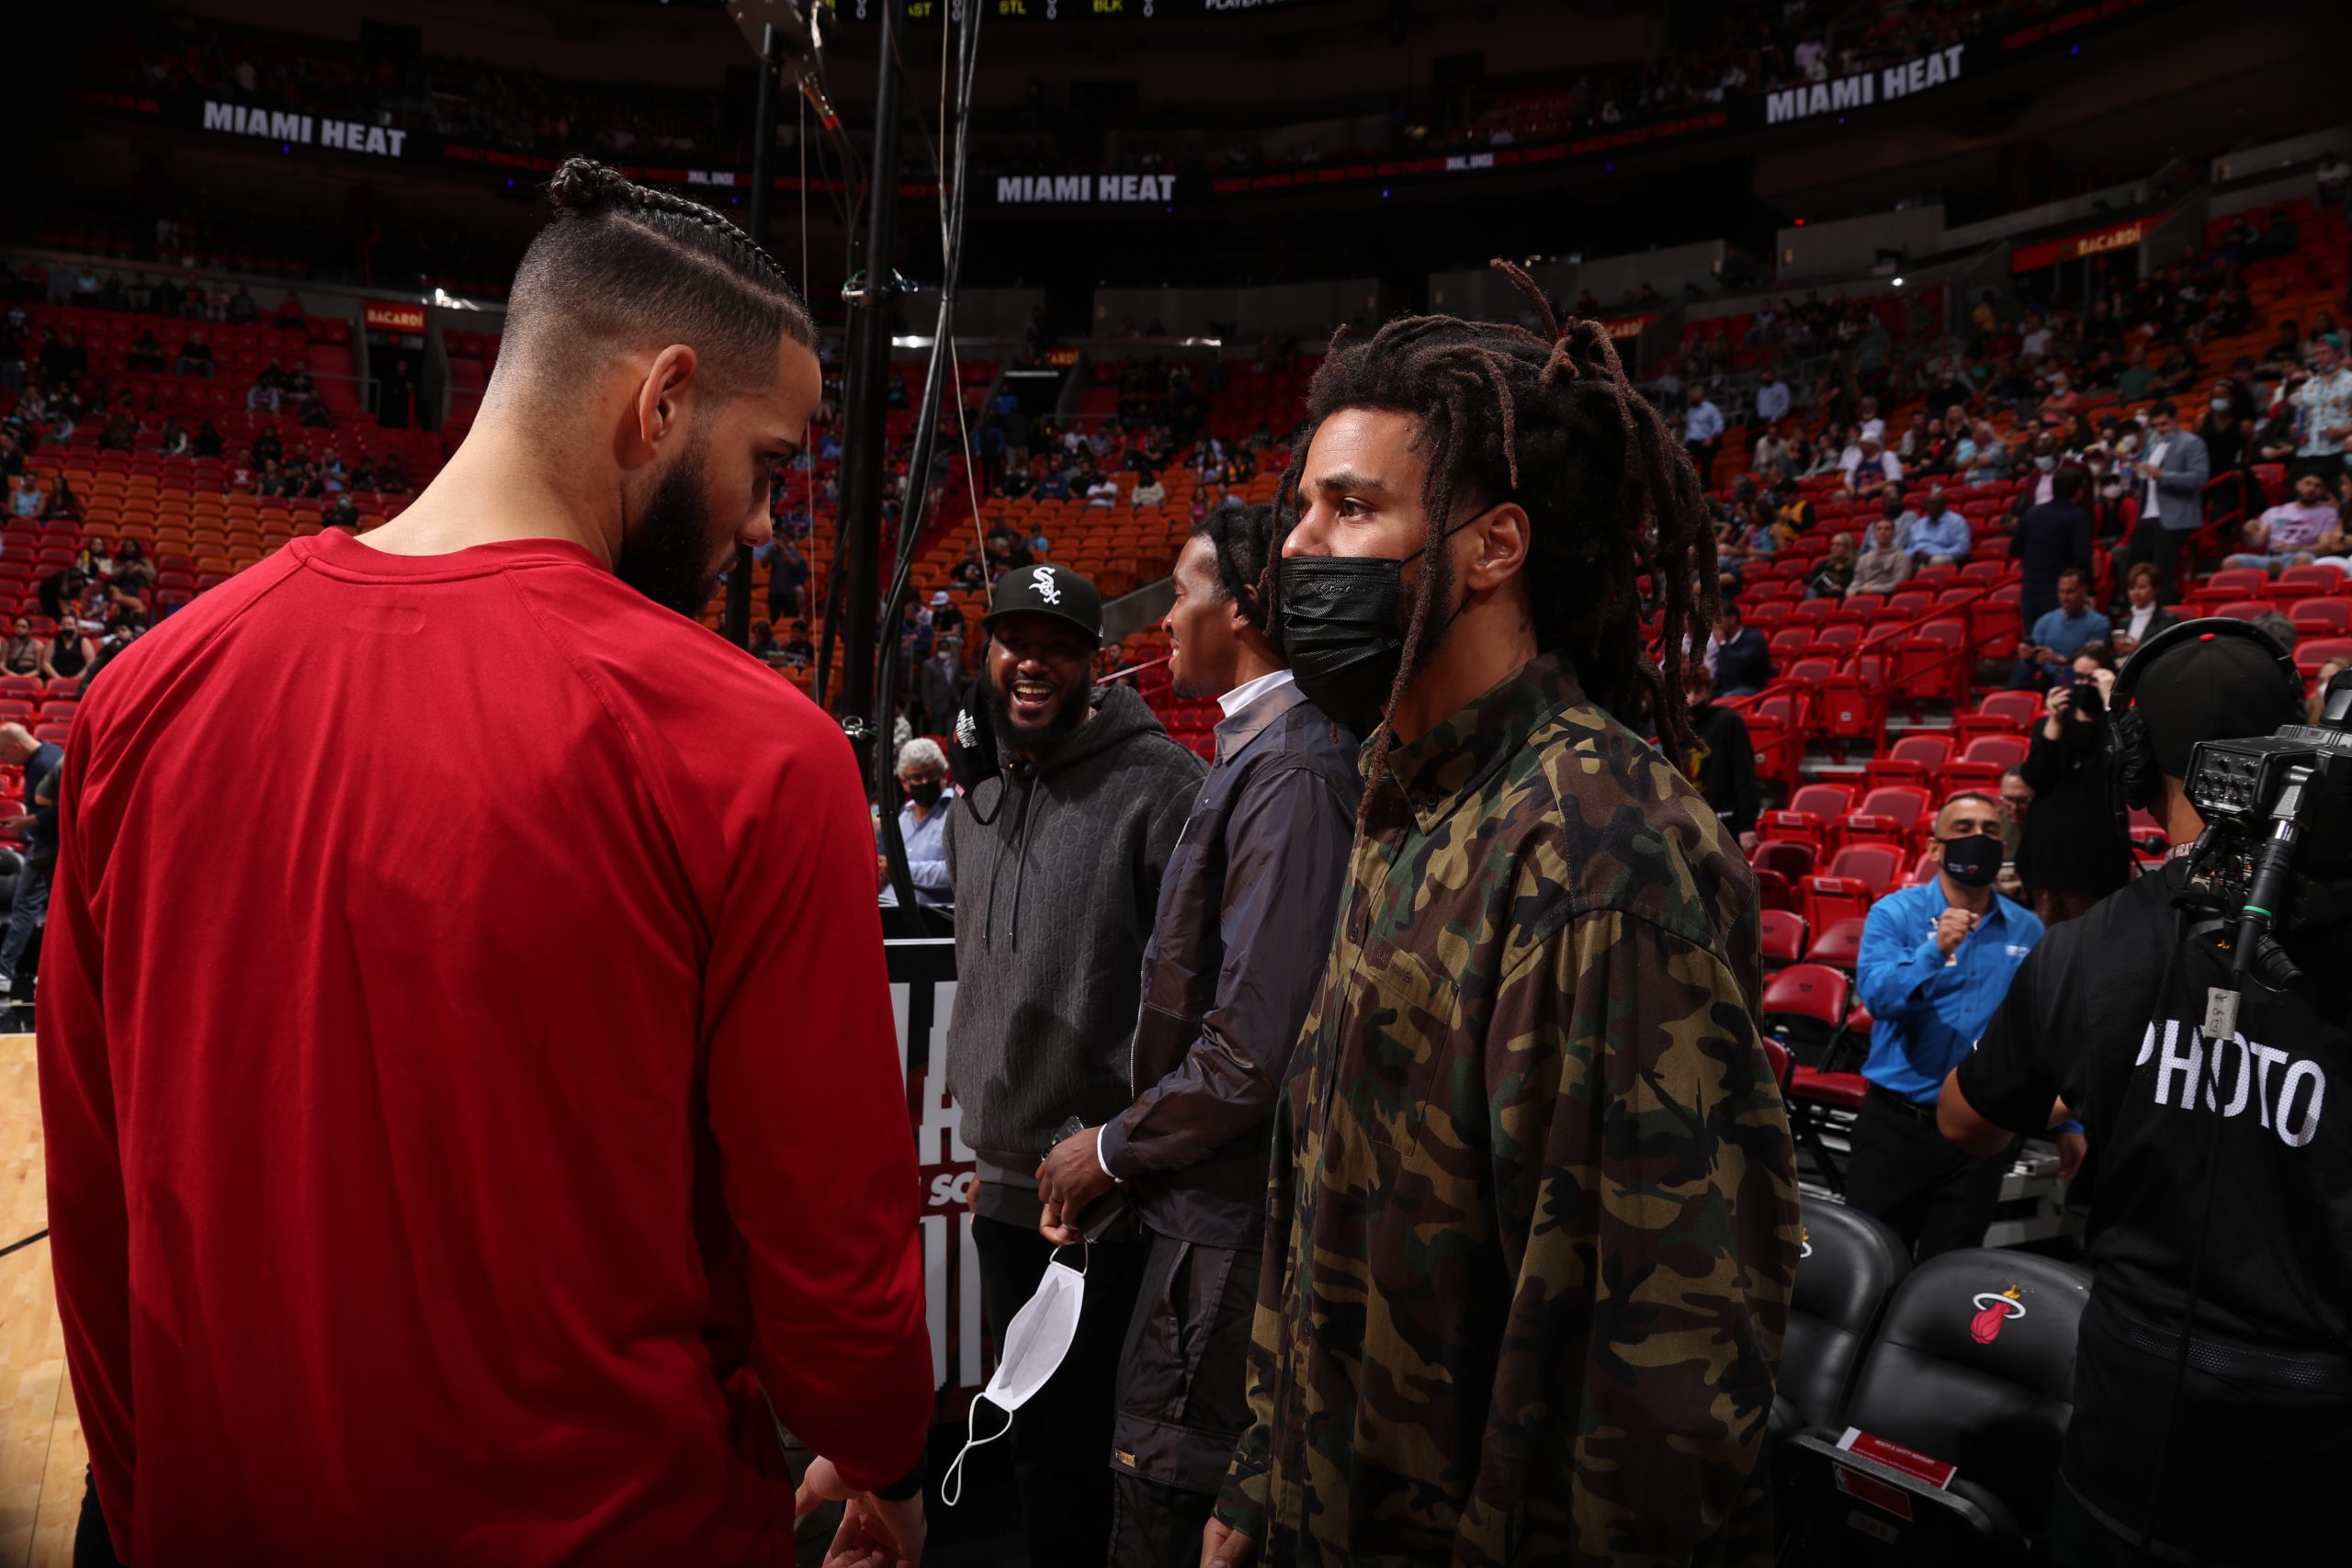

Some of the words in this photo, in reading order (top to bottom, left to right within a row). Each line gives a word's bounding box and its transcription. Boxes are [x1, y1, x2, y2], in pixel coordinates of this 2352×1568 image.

[1766, 72, 1874, 126] MIAMI
[1882, 43, 1965, 102] HEAT
[203, 99, 313, 144] MIAMI
[320, 118, 407, 158] HEAT
[997, 175, 1091, 203] MIAMI
[1098, 174, 1176, 202] HEAT
